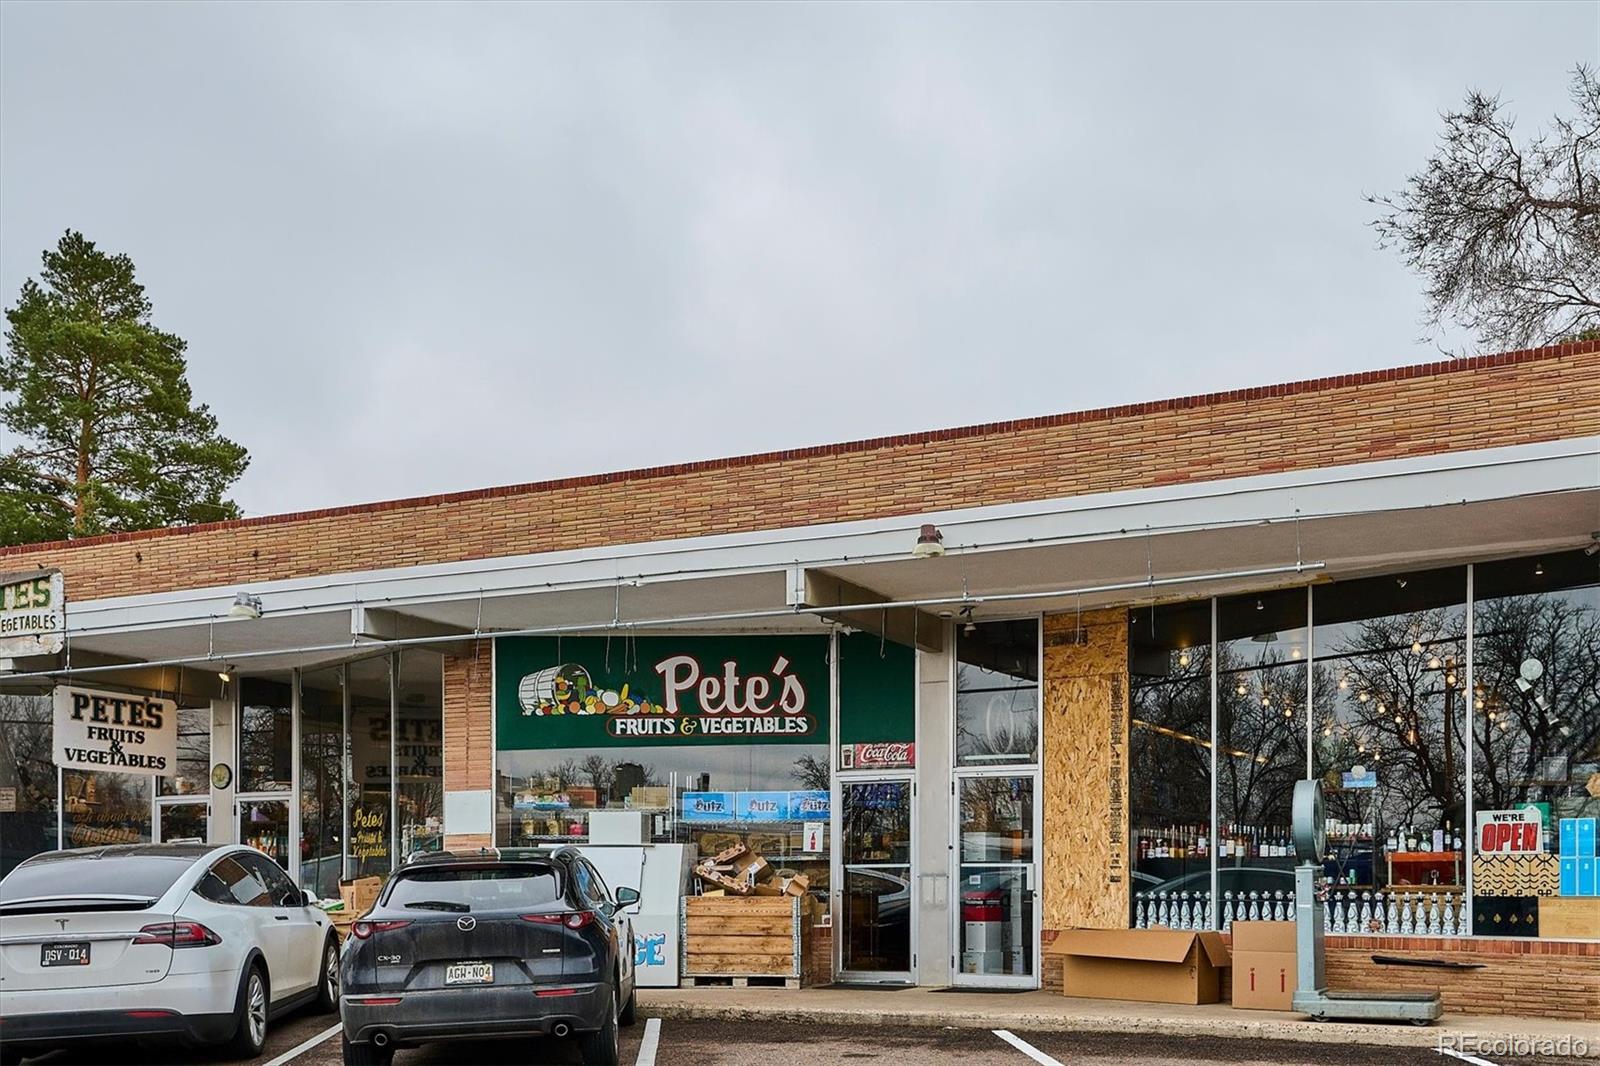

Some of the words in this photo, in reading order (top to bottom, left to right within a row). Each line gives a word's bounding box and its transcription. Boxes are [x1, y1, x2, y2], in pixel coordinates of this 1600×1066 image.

[0, 615, 56, 632] EGETABLES
[655, 655, 805, 714] Pete's
[71, 692, 163, 729] PETE'S
[87, 726, 145, 744] FRUITS
[615, 718, 676, 736] FRUITS
[679, 717, 697, 735] &
[700, 717, 808, 734] VEGETABLES
[110, 740, 123, 753] &
[64, 748, 167, 770] VEGETABLES
[1492, 813, 1525, 822] WE'RE
[1481, 823, 1538, 851] OPEN
